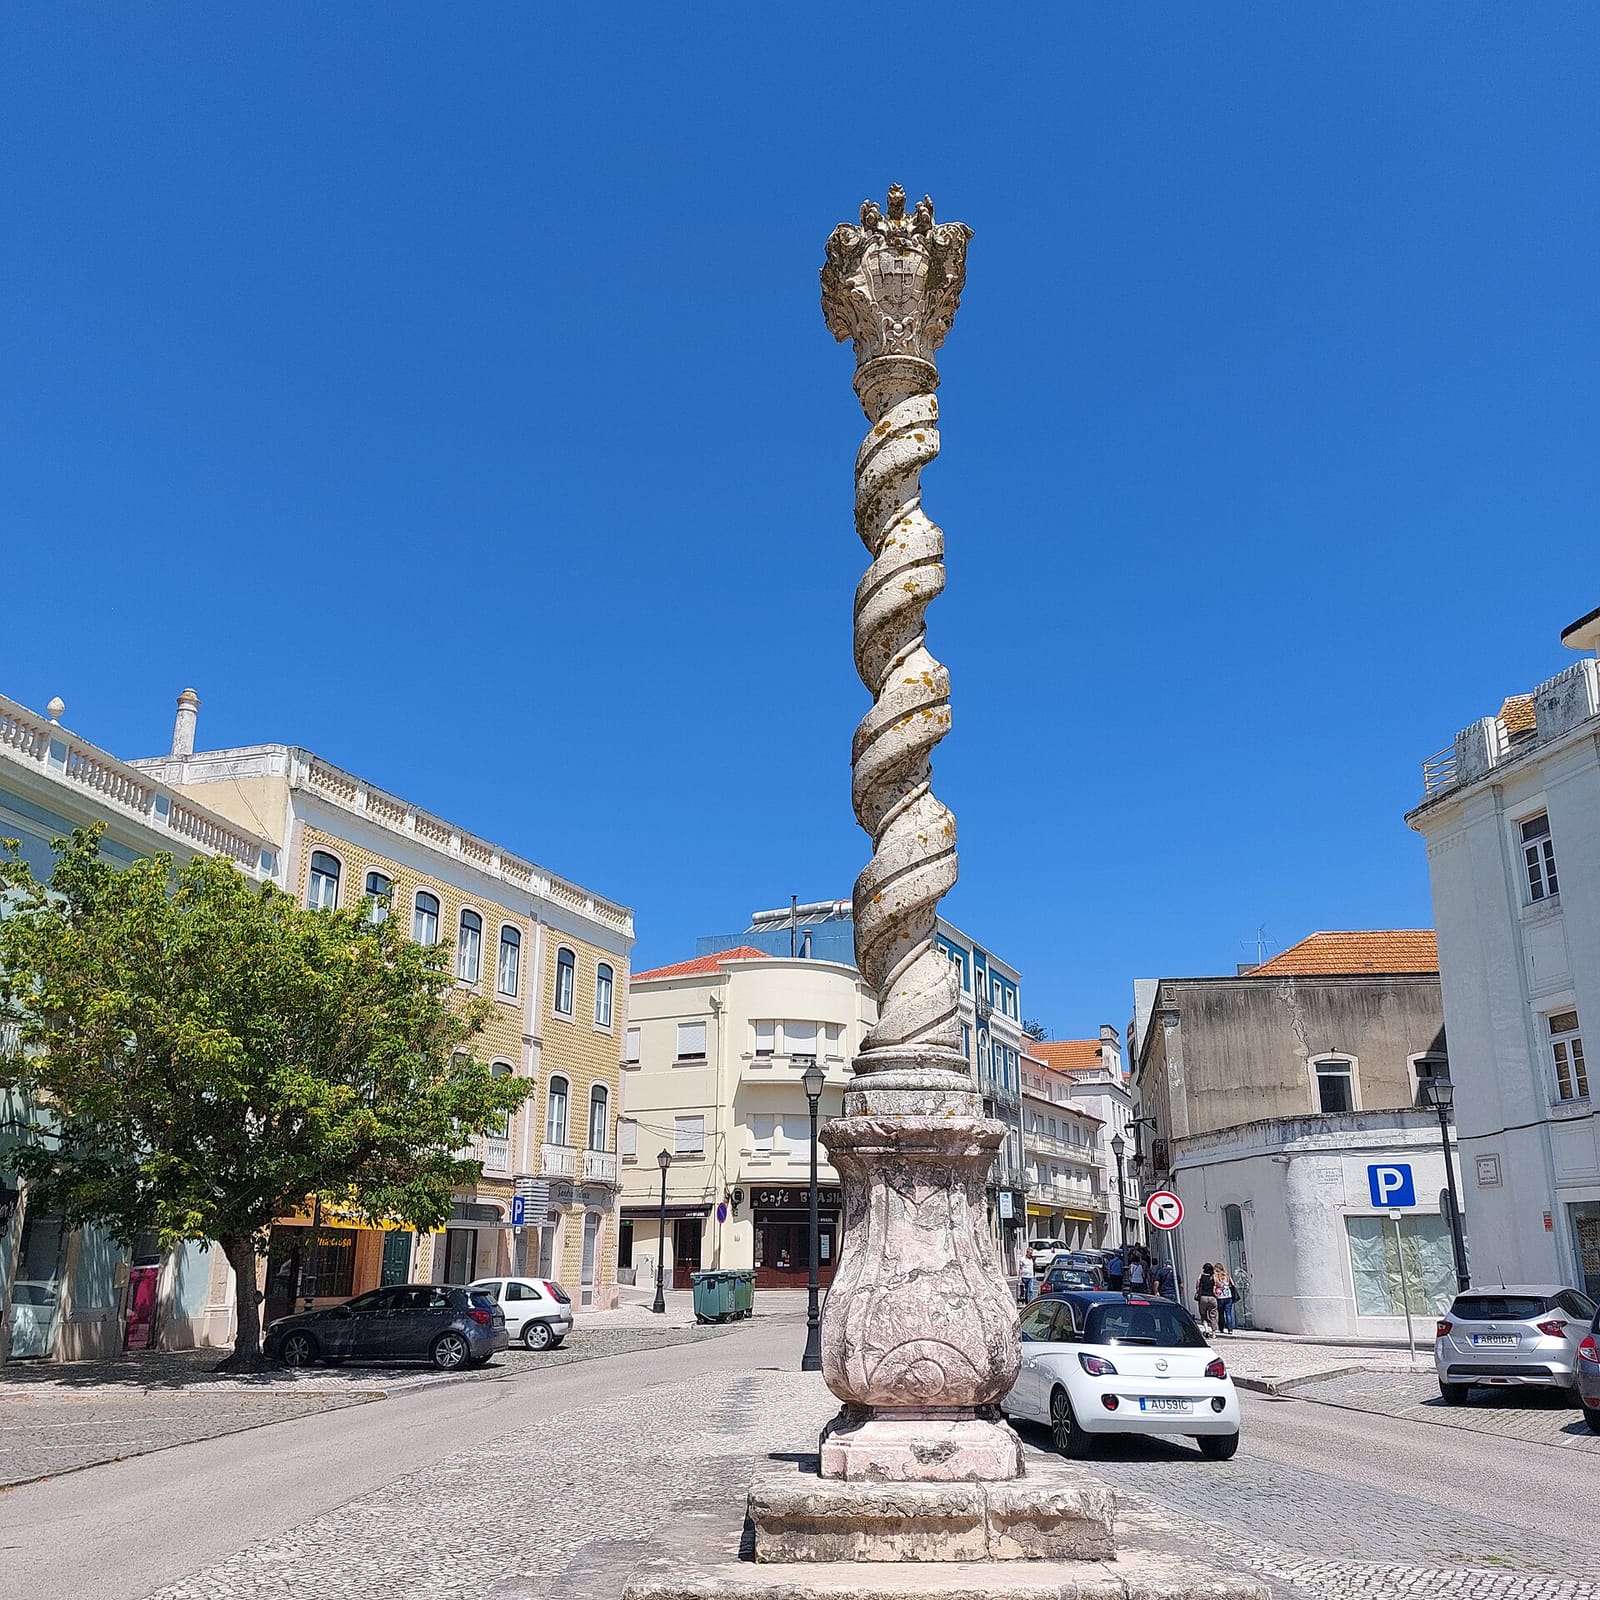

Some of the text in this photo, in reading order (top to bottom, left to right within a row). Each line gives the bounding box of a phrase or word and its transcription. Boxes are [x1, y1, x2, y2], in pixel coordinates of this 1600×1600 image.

[1376, 1167, 1404, 1204] P
[760, 1188, 842, 1207] Café BASIL
[514, 1199, 523, 1222] P
